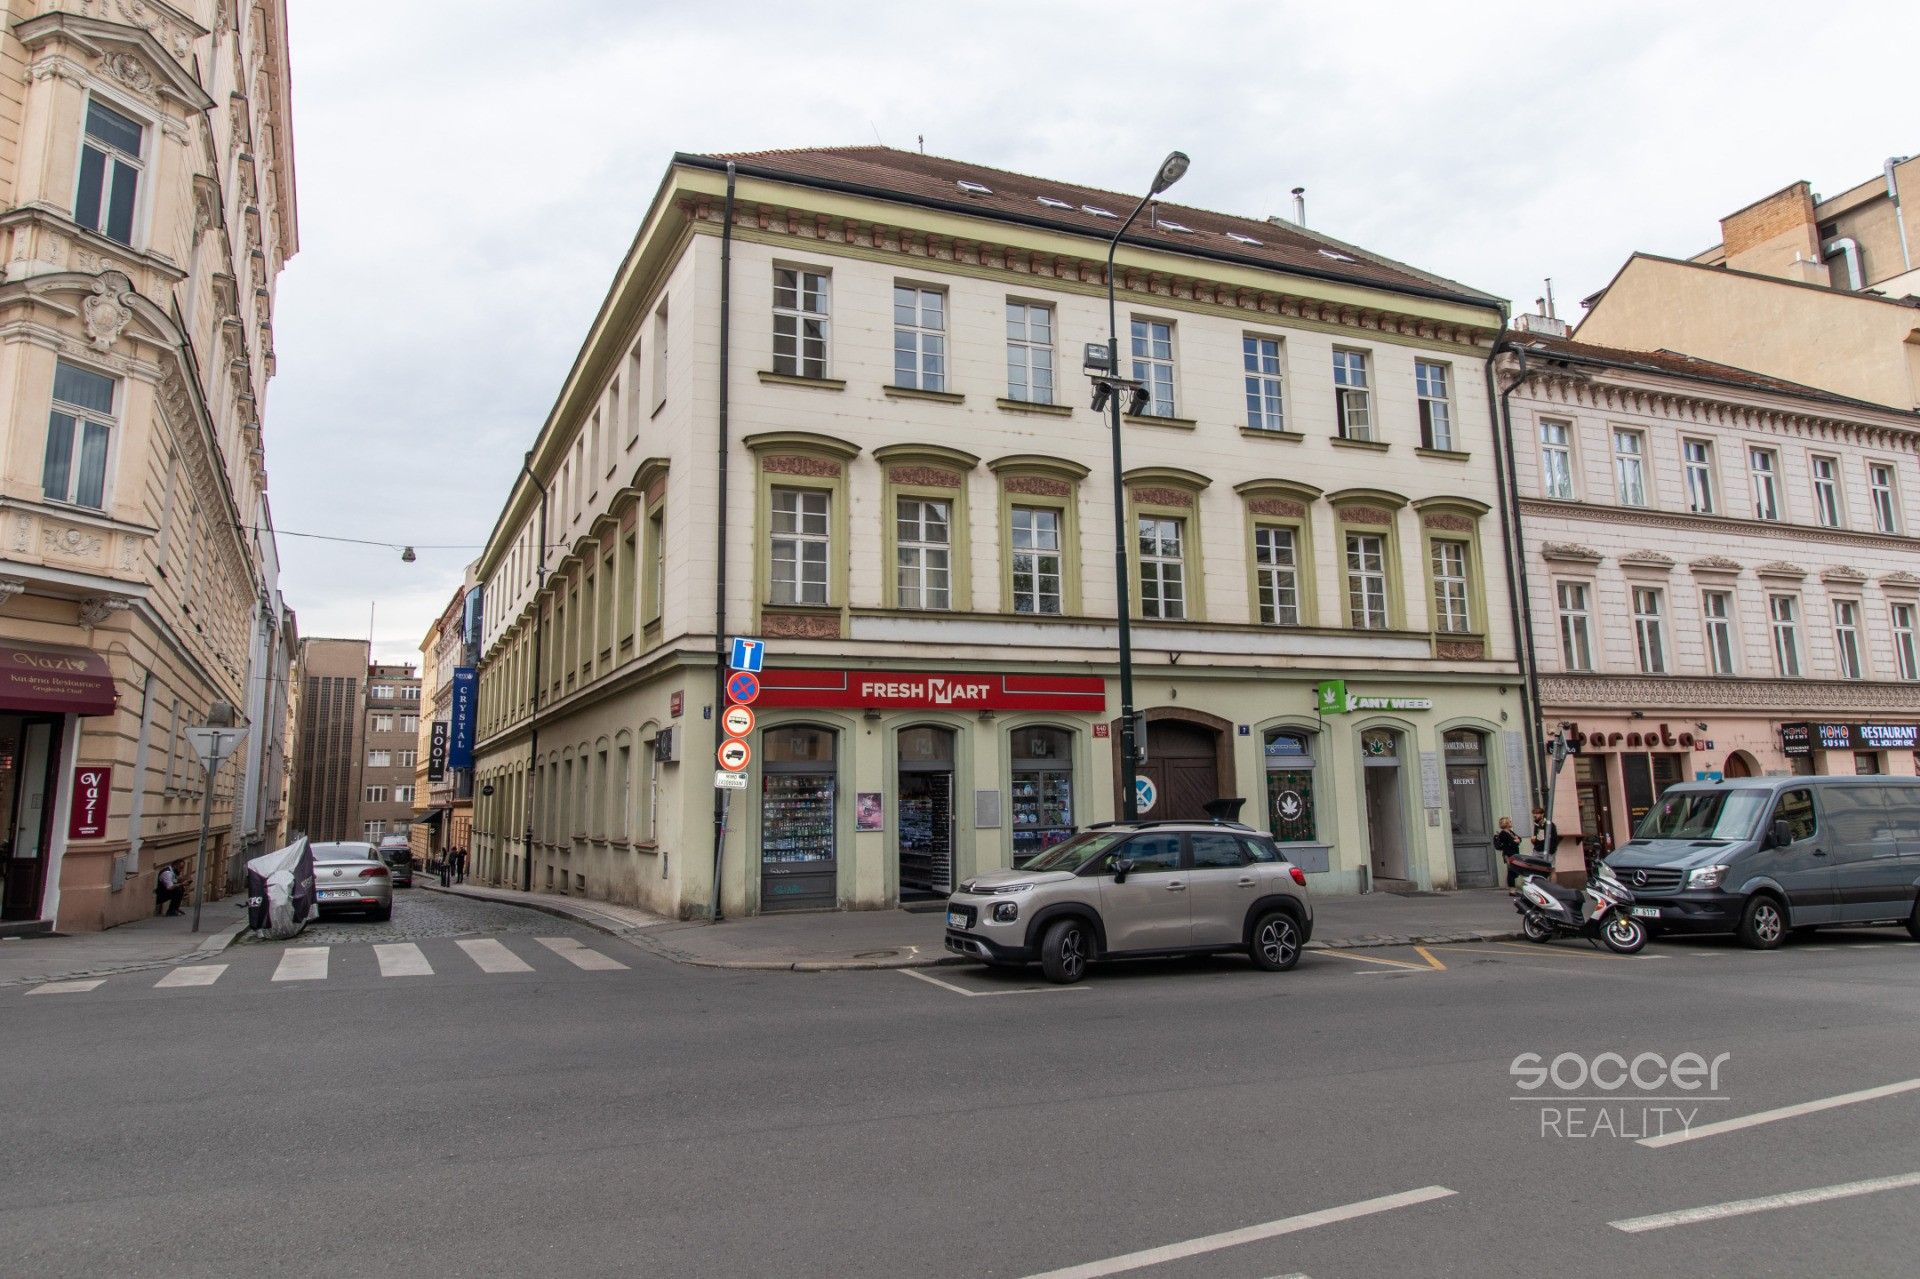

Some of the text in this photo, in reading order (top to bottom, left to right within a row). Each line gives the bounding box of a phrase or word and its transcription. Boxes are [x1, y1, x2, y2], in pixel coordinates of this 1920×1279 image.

[13, 652, 73, 670] Vazi
[861, 679, 990, 704] FRESH MART
[1390, 698, 1432, 710] WEED
[458, 686, 467, 748] CRYSTAL
[1571, 723, 1694, 747] barnota
[1822, 739, 1850, 747] SUSHI
[1860, 726, 1918, 739] RESTAURANT
[433, 725, 444, 768] ROOT
[81, 772, 102, 824] Vazi
